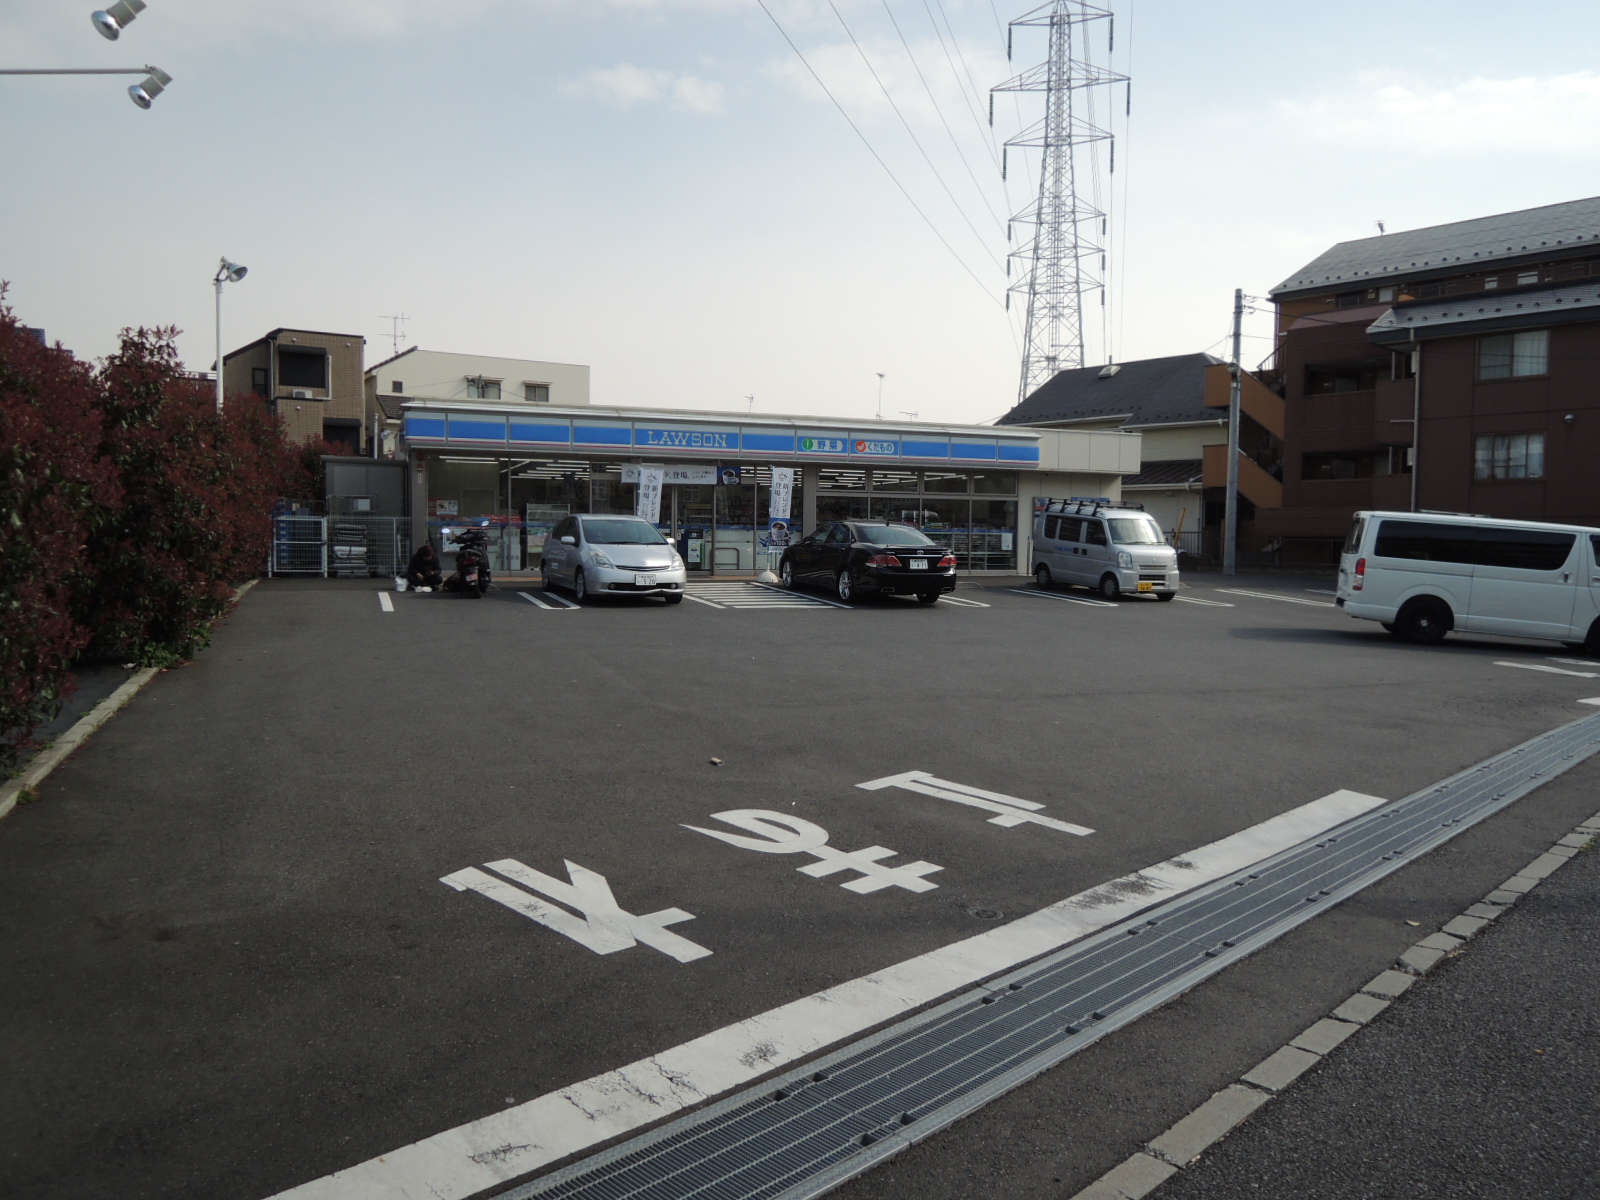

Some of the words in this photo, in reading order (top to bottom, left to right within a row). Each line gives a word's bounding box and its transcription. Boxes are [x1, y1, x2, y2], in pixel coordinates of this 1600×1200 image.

[648, 431, 727, 448] LAWSON
[817, 439, 838, 451] 野菜
[867, 441, 893, 453] くだもの
